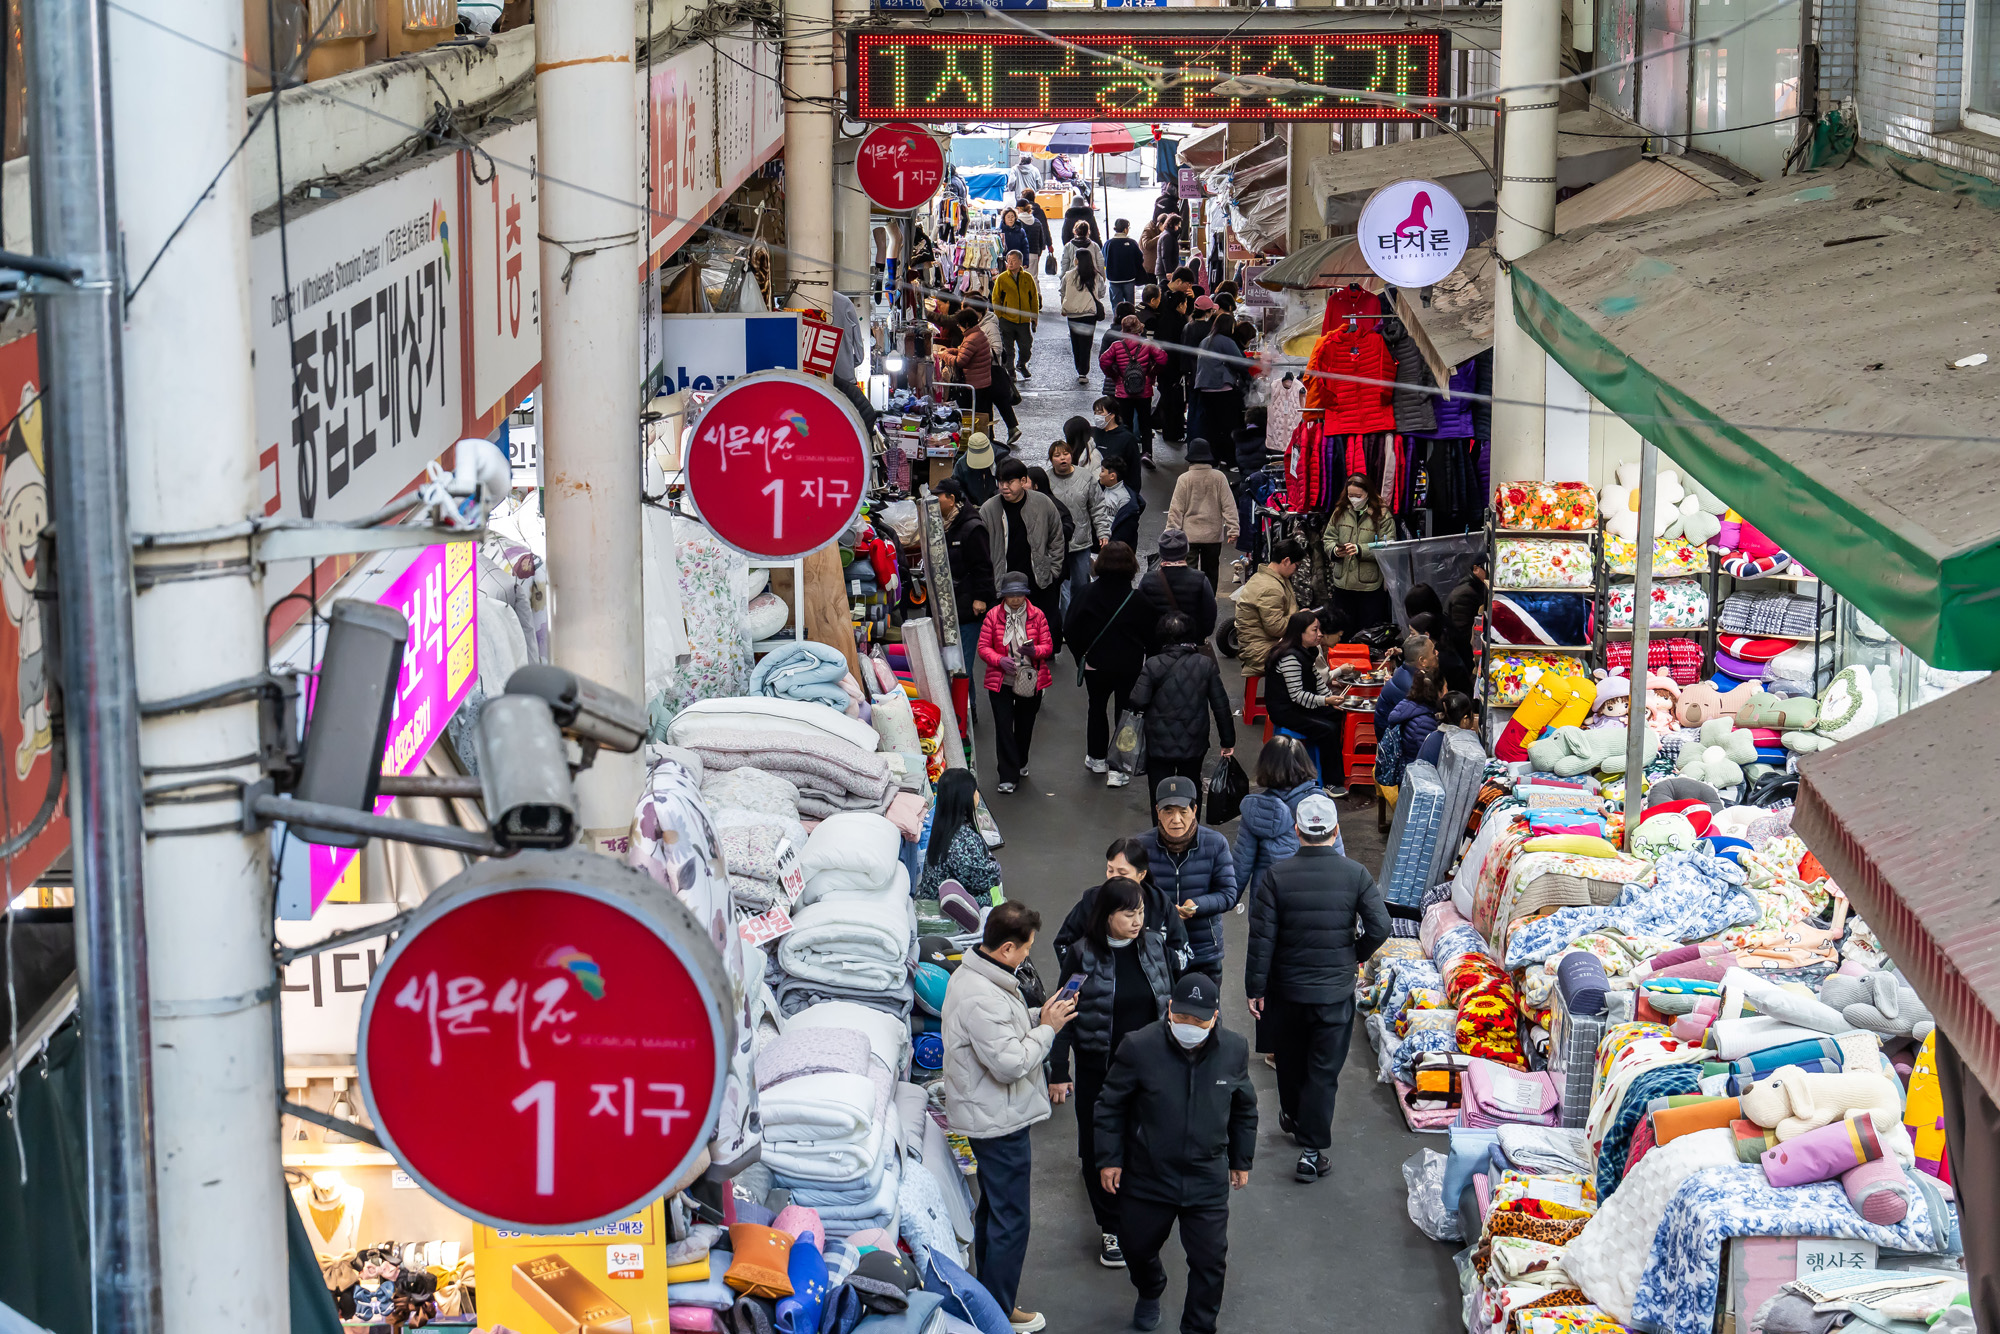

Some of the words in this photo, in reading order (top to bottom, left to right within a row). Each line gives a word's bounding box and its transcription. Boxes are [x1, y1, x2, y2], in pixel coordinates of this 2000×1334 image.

[892, 170, 904, 201] 1
[911, 169, 937, 185] 지구
[271, 291, 296, 328] Distrct
[302, 266, 334, 310] Wholesale
[335, 254, 361, 292] Shopping
[362, 246, 380, 277] Center
[291, 256, 446, 519] 종합도매상가
[761, 478, 784, 539] 1
[800, 477, 852, 508] 지구
[394, 970, 577, 1069] 서문시장
[511, 1080, 555, 1196] 1
[588, 1076, 691, 1137] 지구
